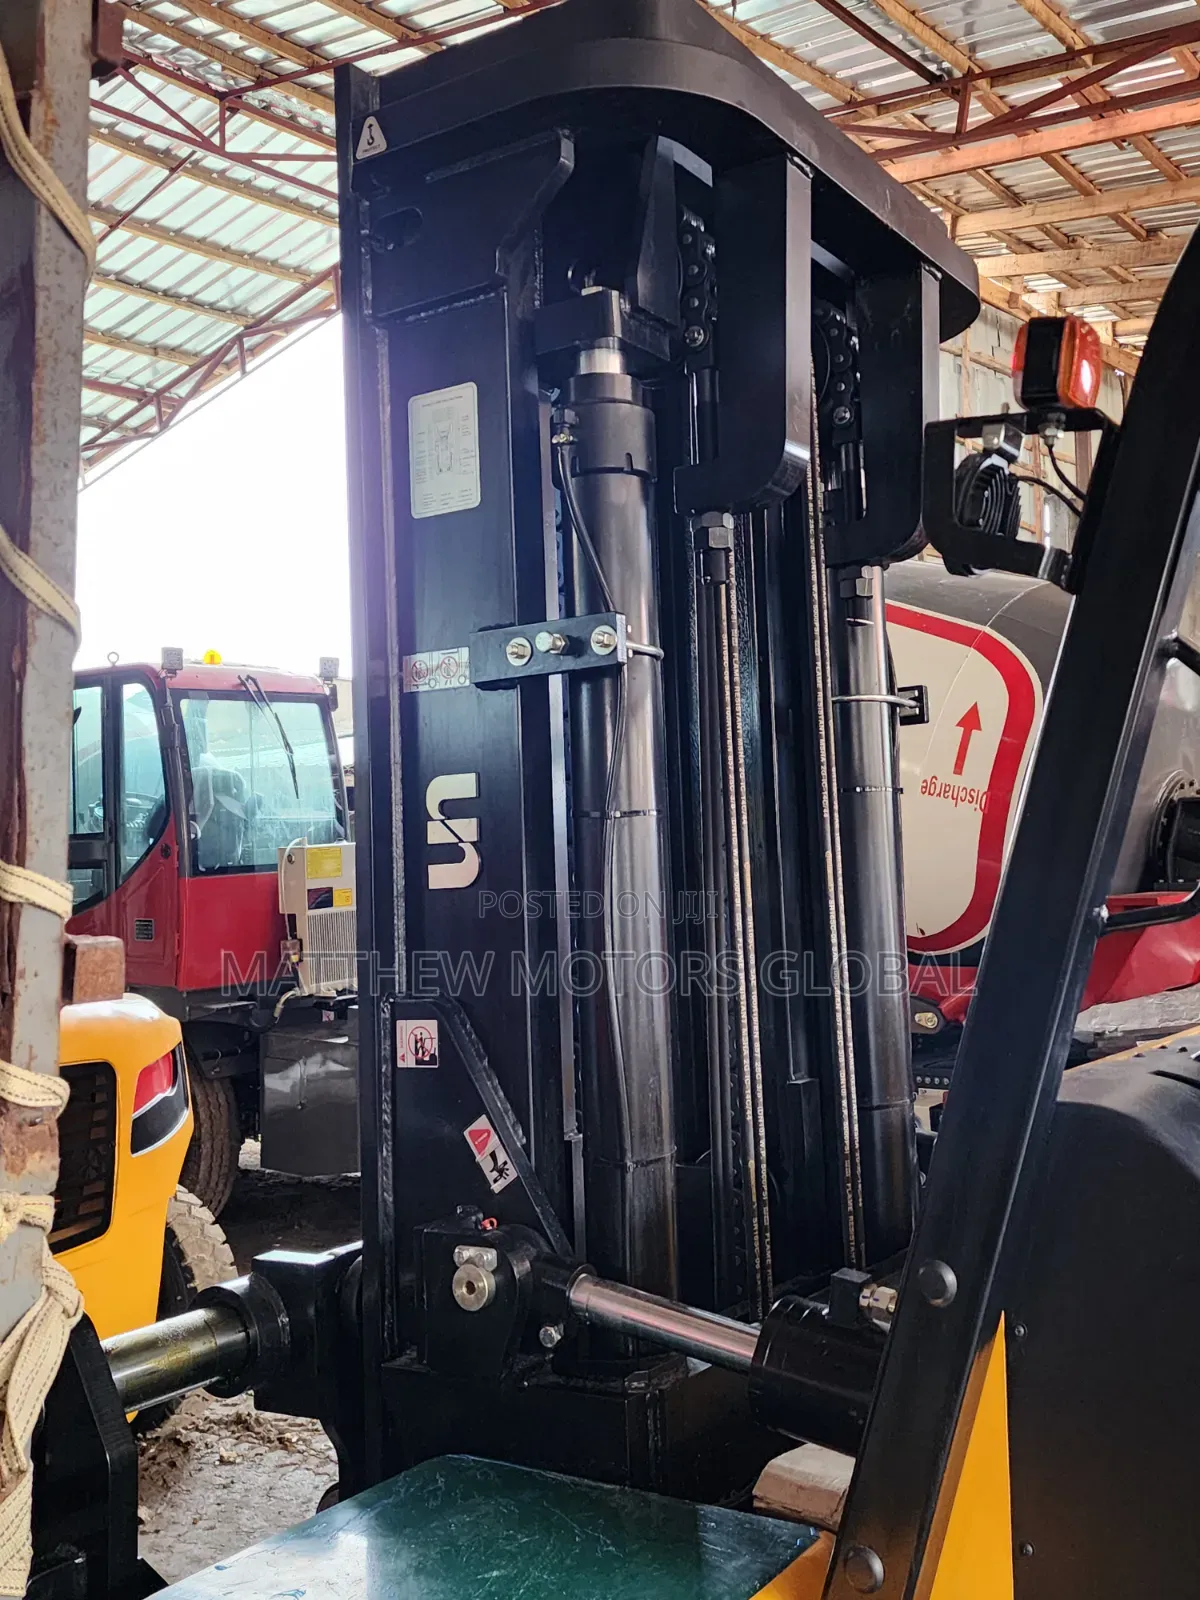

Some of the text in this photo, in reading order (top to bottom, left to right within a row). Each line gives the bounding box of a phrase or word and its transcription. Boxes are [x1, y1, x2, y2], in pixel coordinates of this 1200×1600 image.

[920, 776, 991, 814] Discharge
[746, 915, 755, 964] SR16SC-06
[828, 899, 837, 944] SR16SC-06
[738, 972, 747, 1024] RESISTANT
[743, 1060, 752, 1120] 2G-IC-14C/44
